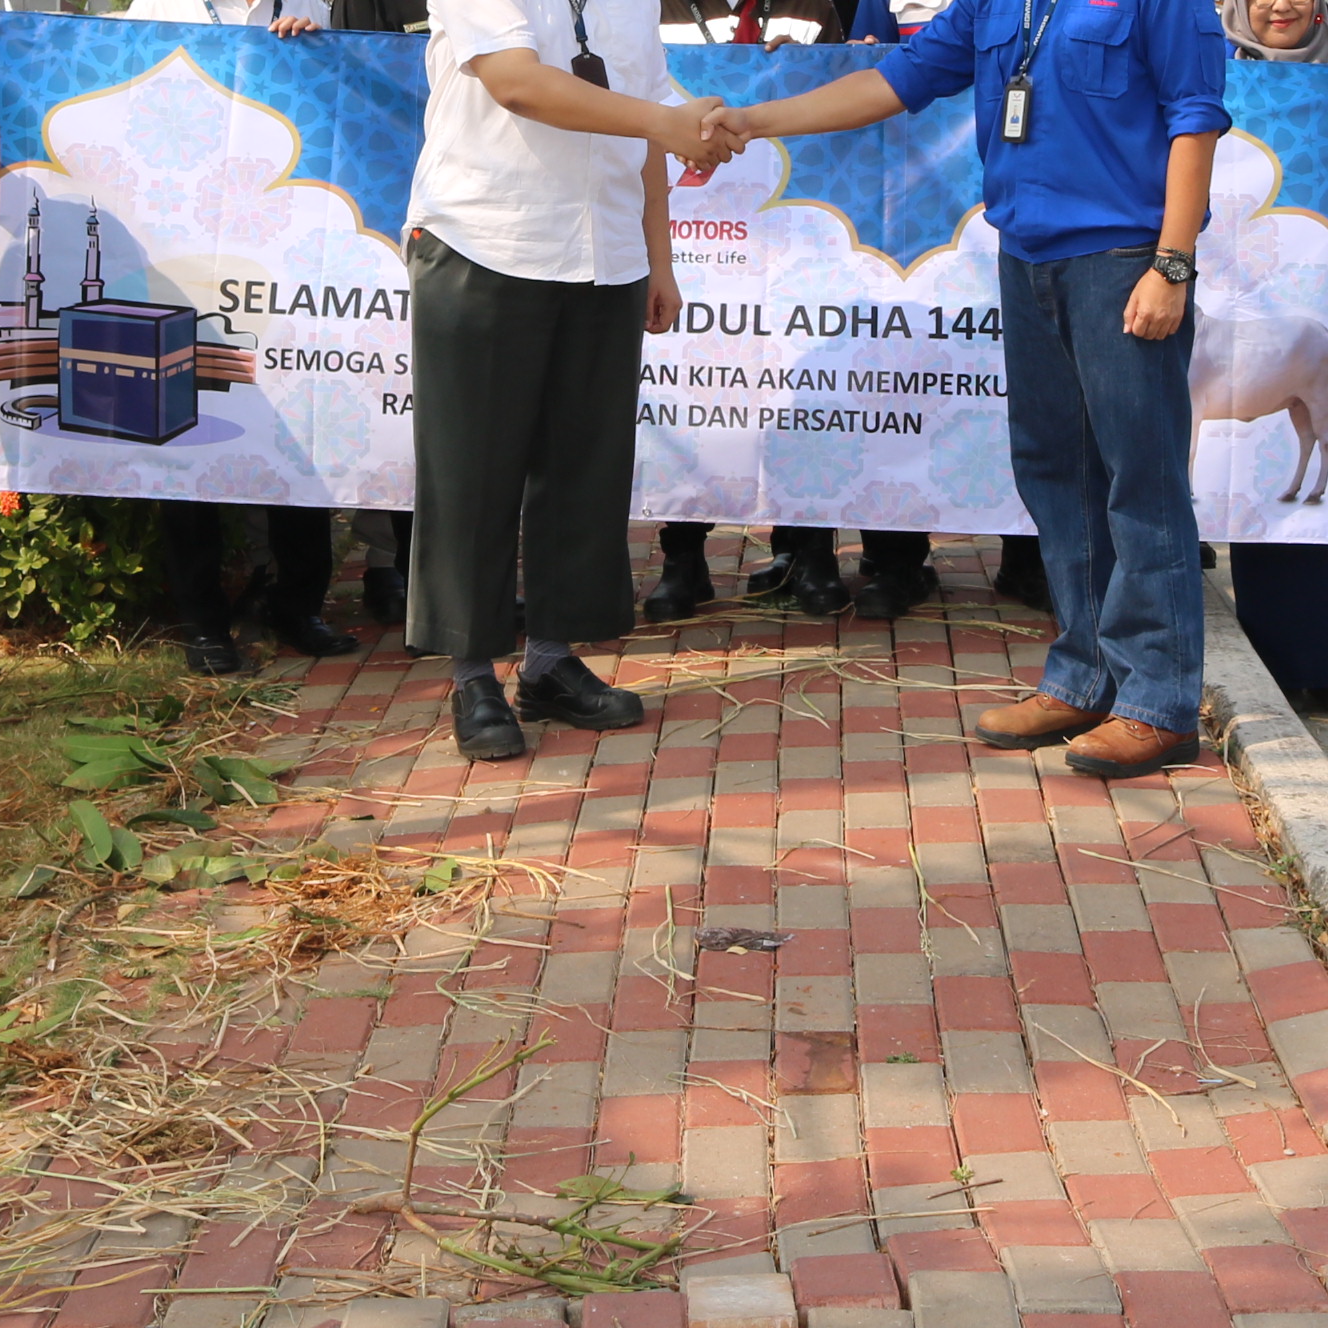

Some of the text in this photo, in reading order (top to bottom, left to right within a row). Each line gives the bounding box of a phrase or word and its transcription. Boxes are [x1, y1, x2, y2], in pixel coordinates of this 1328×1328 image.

[671, 251, 747, 264] etter Life
[218, 278, 411, 322] SELAMAT
[784, 304, 913, 340] ADHA
[928, 306, 1003, 342] 144
[264, 347, 386, 375] SEMOGA
[639, 363, 1008, 397] AN KITA AKAN MEMPERKU
[635, 402, 923, 435] AN DAN PERSATUAN
